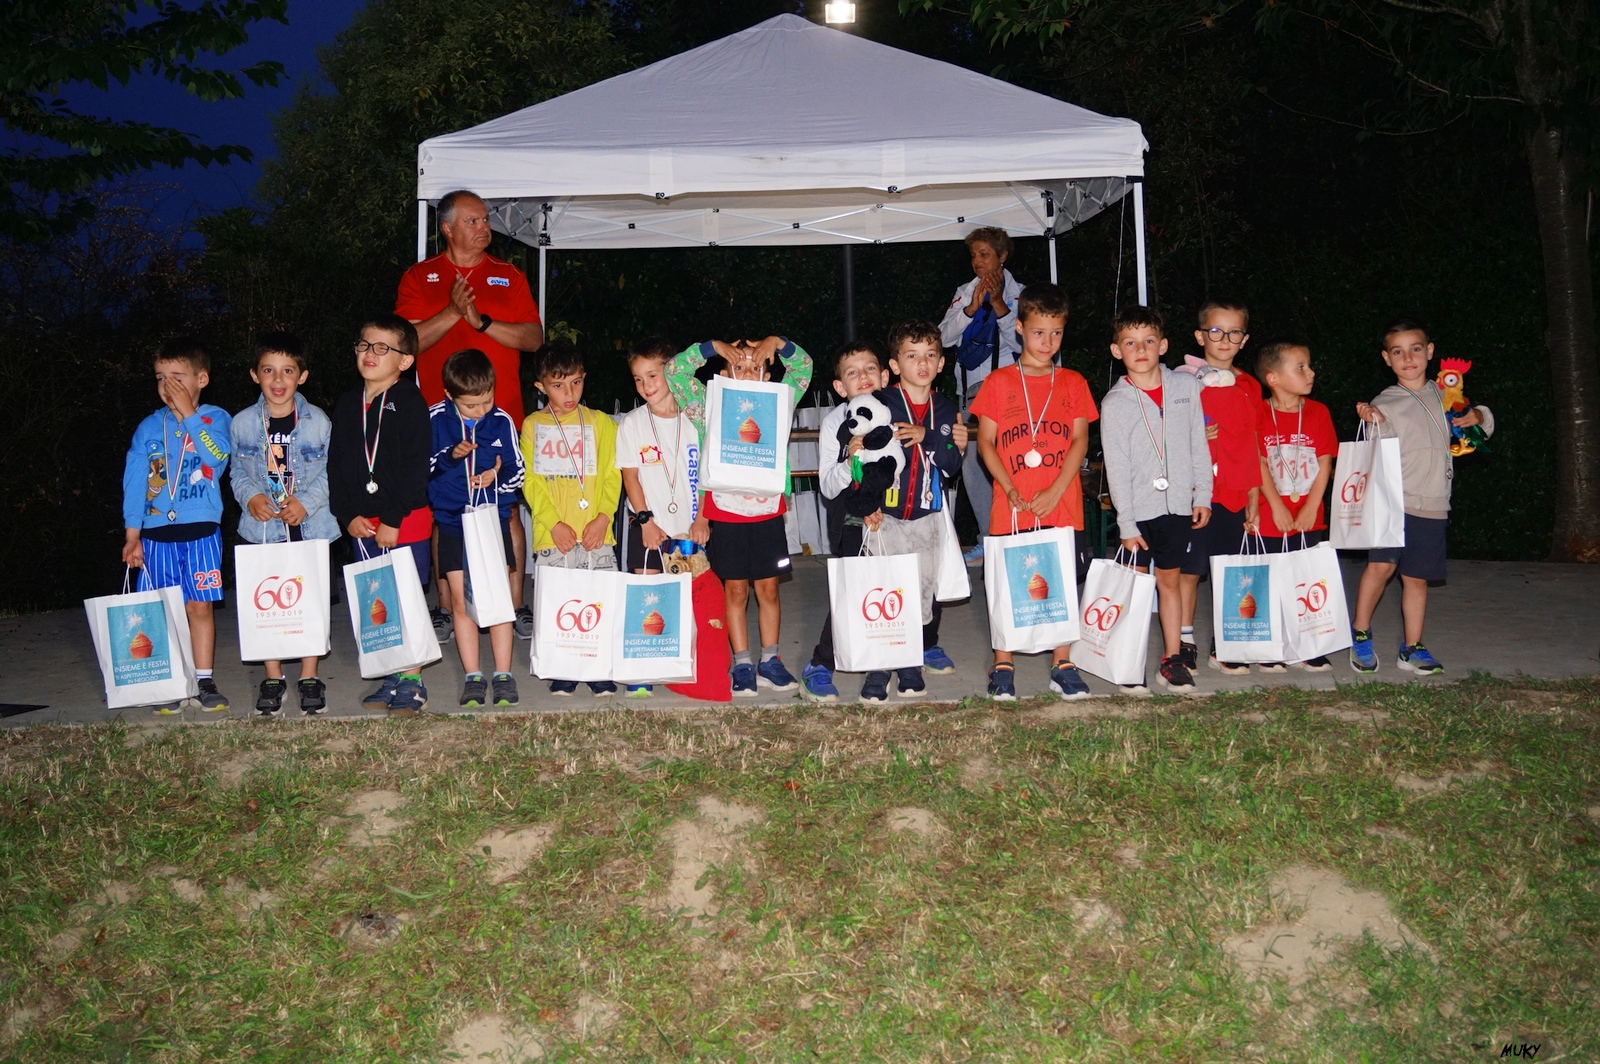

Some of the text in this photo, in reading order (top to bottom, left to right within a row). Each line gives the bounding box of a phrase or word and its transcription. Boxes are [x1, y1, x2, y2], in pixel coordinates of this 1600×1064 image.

[198, 429, 223, 461] PATROL
[541, 439, 583, 459] 404
[722, 444, 747, 453] INSIEME
[755, 448, 775, 456] FESTA!
[1341, 471, 1367, 503] 60
[194, 569, 223, 590] 23
[254, 576, 303, 611] 60
[256, 609, 303, 618] 1959-2019
[862, 587, 903, 622] 60
[1014, 605, 1040, 614] INSIEME
[1049, 602, 1065, 610] FESTA!
[1084, 596, 1121, 631] 60
[556, 599, 601, 632] 60
[865, 621, 905, 629] 1959-2019
[557, 632, 600, 640] 1959-2019
[115, 664, 141, 673] INSIEME
[148, 660, 169, 669] FESTA!
